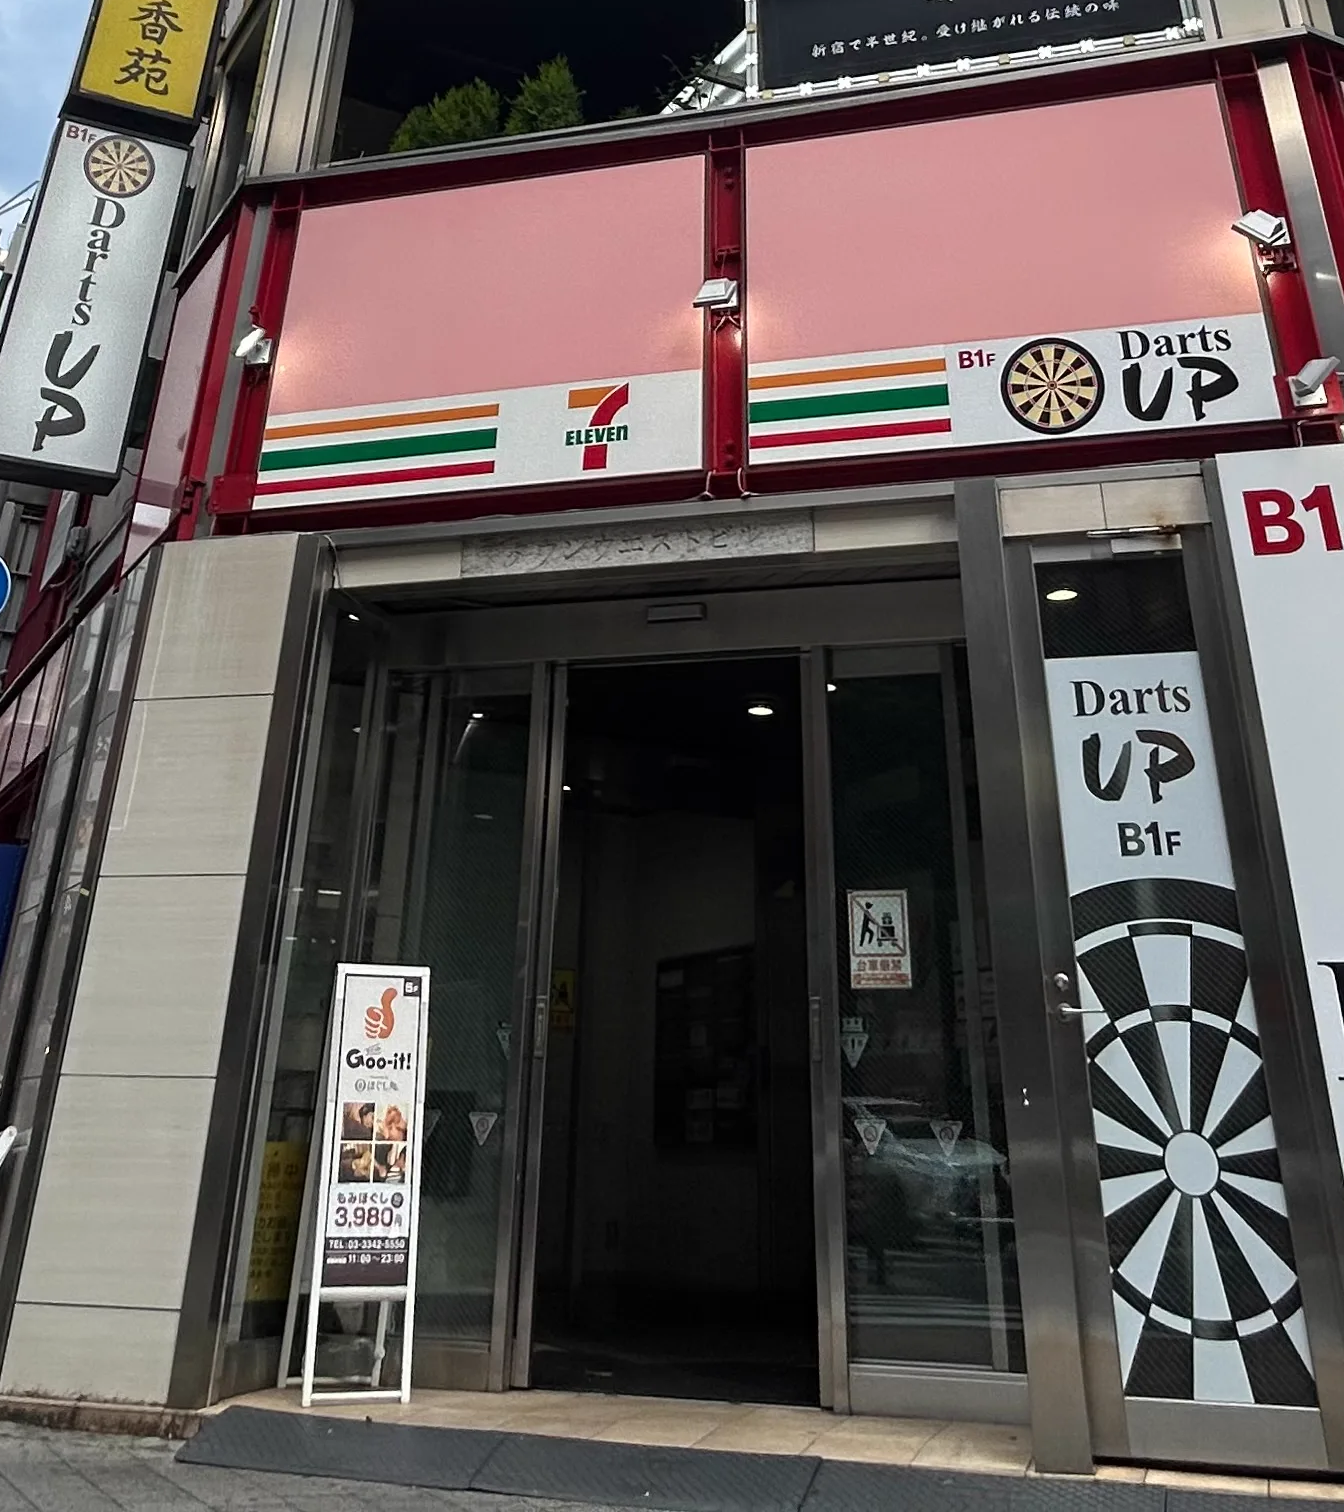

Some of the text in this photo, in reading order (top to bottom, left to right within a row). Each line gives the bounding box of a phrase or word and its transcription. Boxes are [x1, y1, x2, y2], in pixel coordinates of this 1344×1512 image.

[66, 125, 96, 144] B1F
[71, 195, 125, 326] Darts
[957, 349, 996, 370] B1F
[1118, 324, 1232, 361] Darts
[32, 330, 100, 452] UP
[1123, 356, 1239, 422] UP
[565, 425, 629, 447] ELEVEN
[1070, 679, 1191, 717] Darts
[1081, 729, 1195, 804] UP
[1117, 820, 1181, 858] B1F
[346, 1048, 411, 1070] Goo-it!
[337, 1191, 390, 1206] もみほぐし
